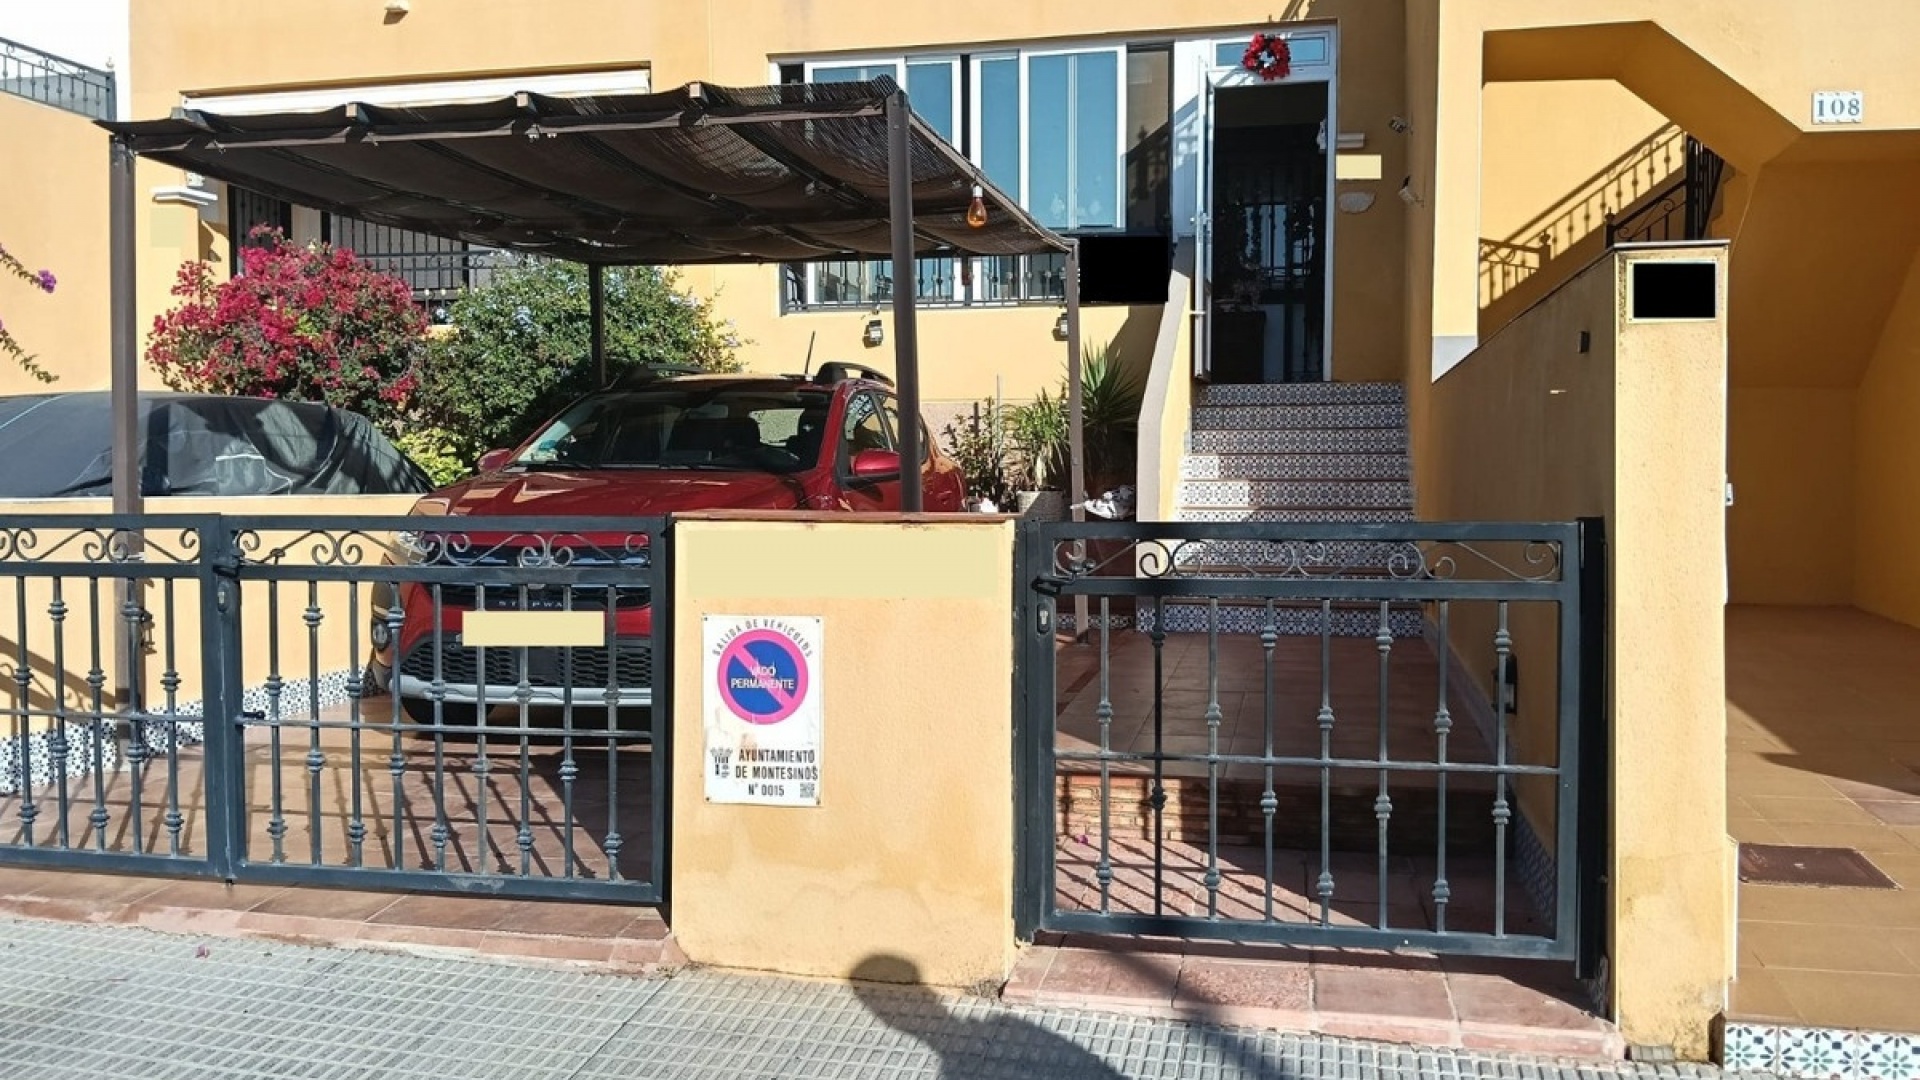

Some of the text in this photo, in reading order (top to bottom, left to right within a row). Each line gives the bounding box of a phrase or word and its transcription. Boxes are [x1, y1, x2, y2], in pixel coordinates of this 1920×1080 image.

[1817, 98, 1860, 117] 108
[712, 624, 742, 656] SALIDA
[745, 618, 758, 630] DE
[730, 677, 795, 689] PERMANENTE
[738, 748, 815, 764] AYUNTAMIENTO
[735, 765, 818, 781] DE MONTESINOS
[761, 783, 785, 797] 0015
